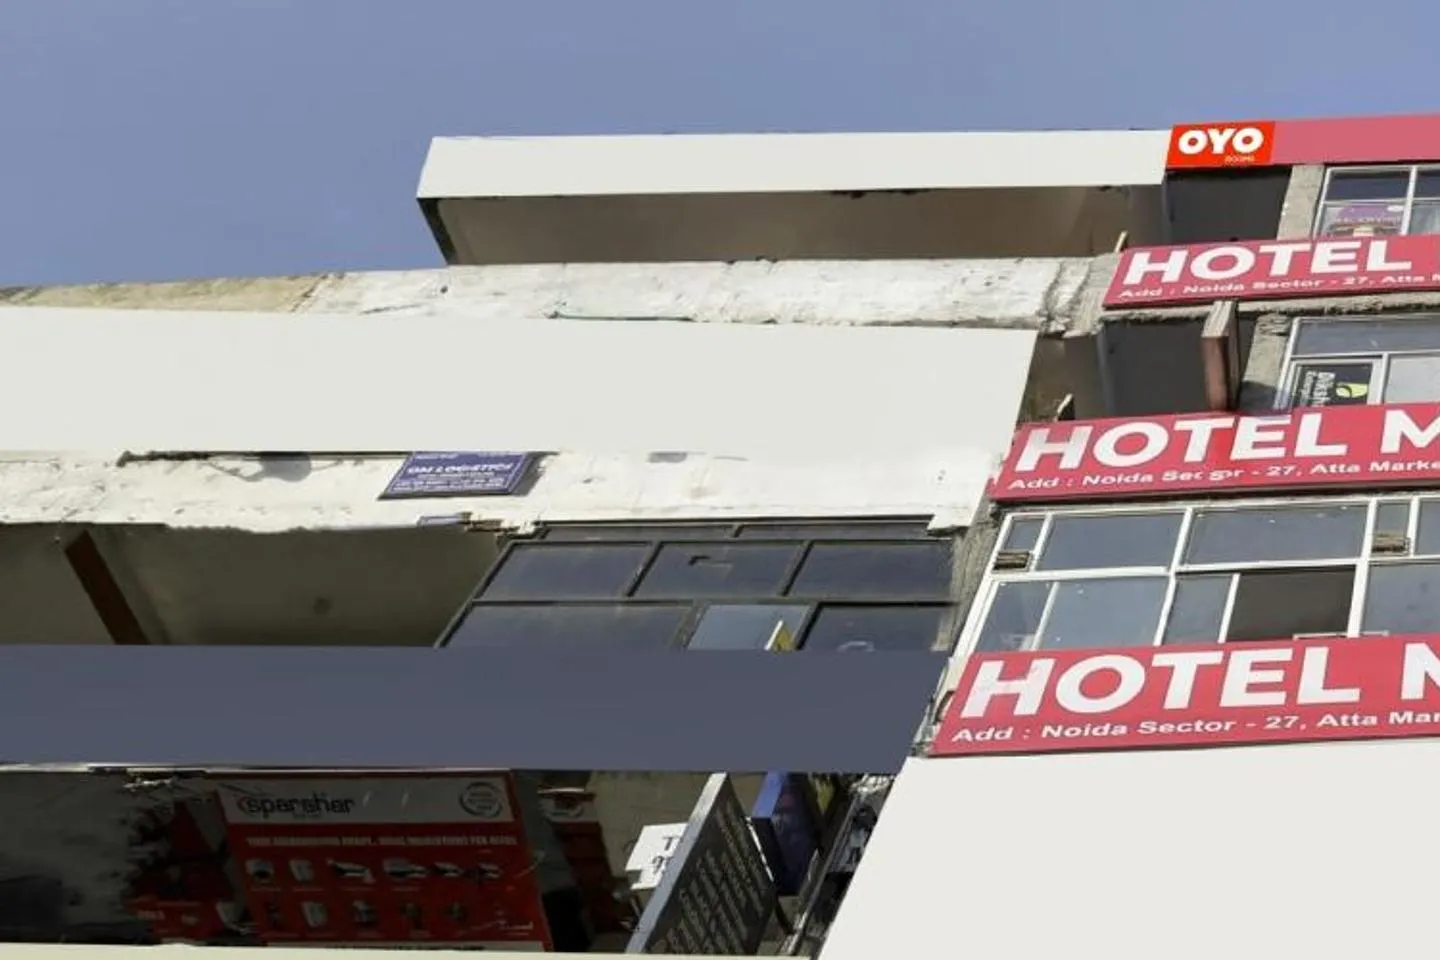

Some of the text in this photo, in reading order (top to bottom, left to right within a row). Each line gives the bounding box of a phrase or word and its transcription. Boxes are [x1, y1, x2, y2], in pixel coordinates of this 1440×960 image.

[1178, 127, 1264, 154] OYO
[1122, 237, 1412, 285] HOTEL
[1013, 413, 1349, 472] HOTEL
[1007, 478, 1060, 491] Add
[1082, 473, 1154, 487] Noida
[1309, 464, 1361, 475] Atta
[960, 646, 1361, 719] HOTEL
[951, 727, 1014, 743] Add
[1041, 721, 1128, 739] Noida
[1137, 718, 1237, 735] Sector
[1316, 713, 1378, 728] Atta
